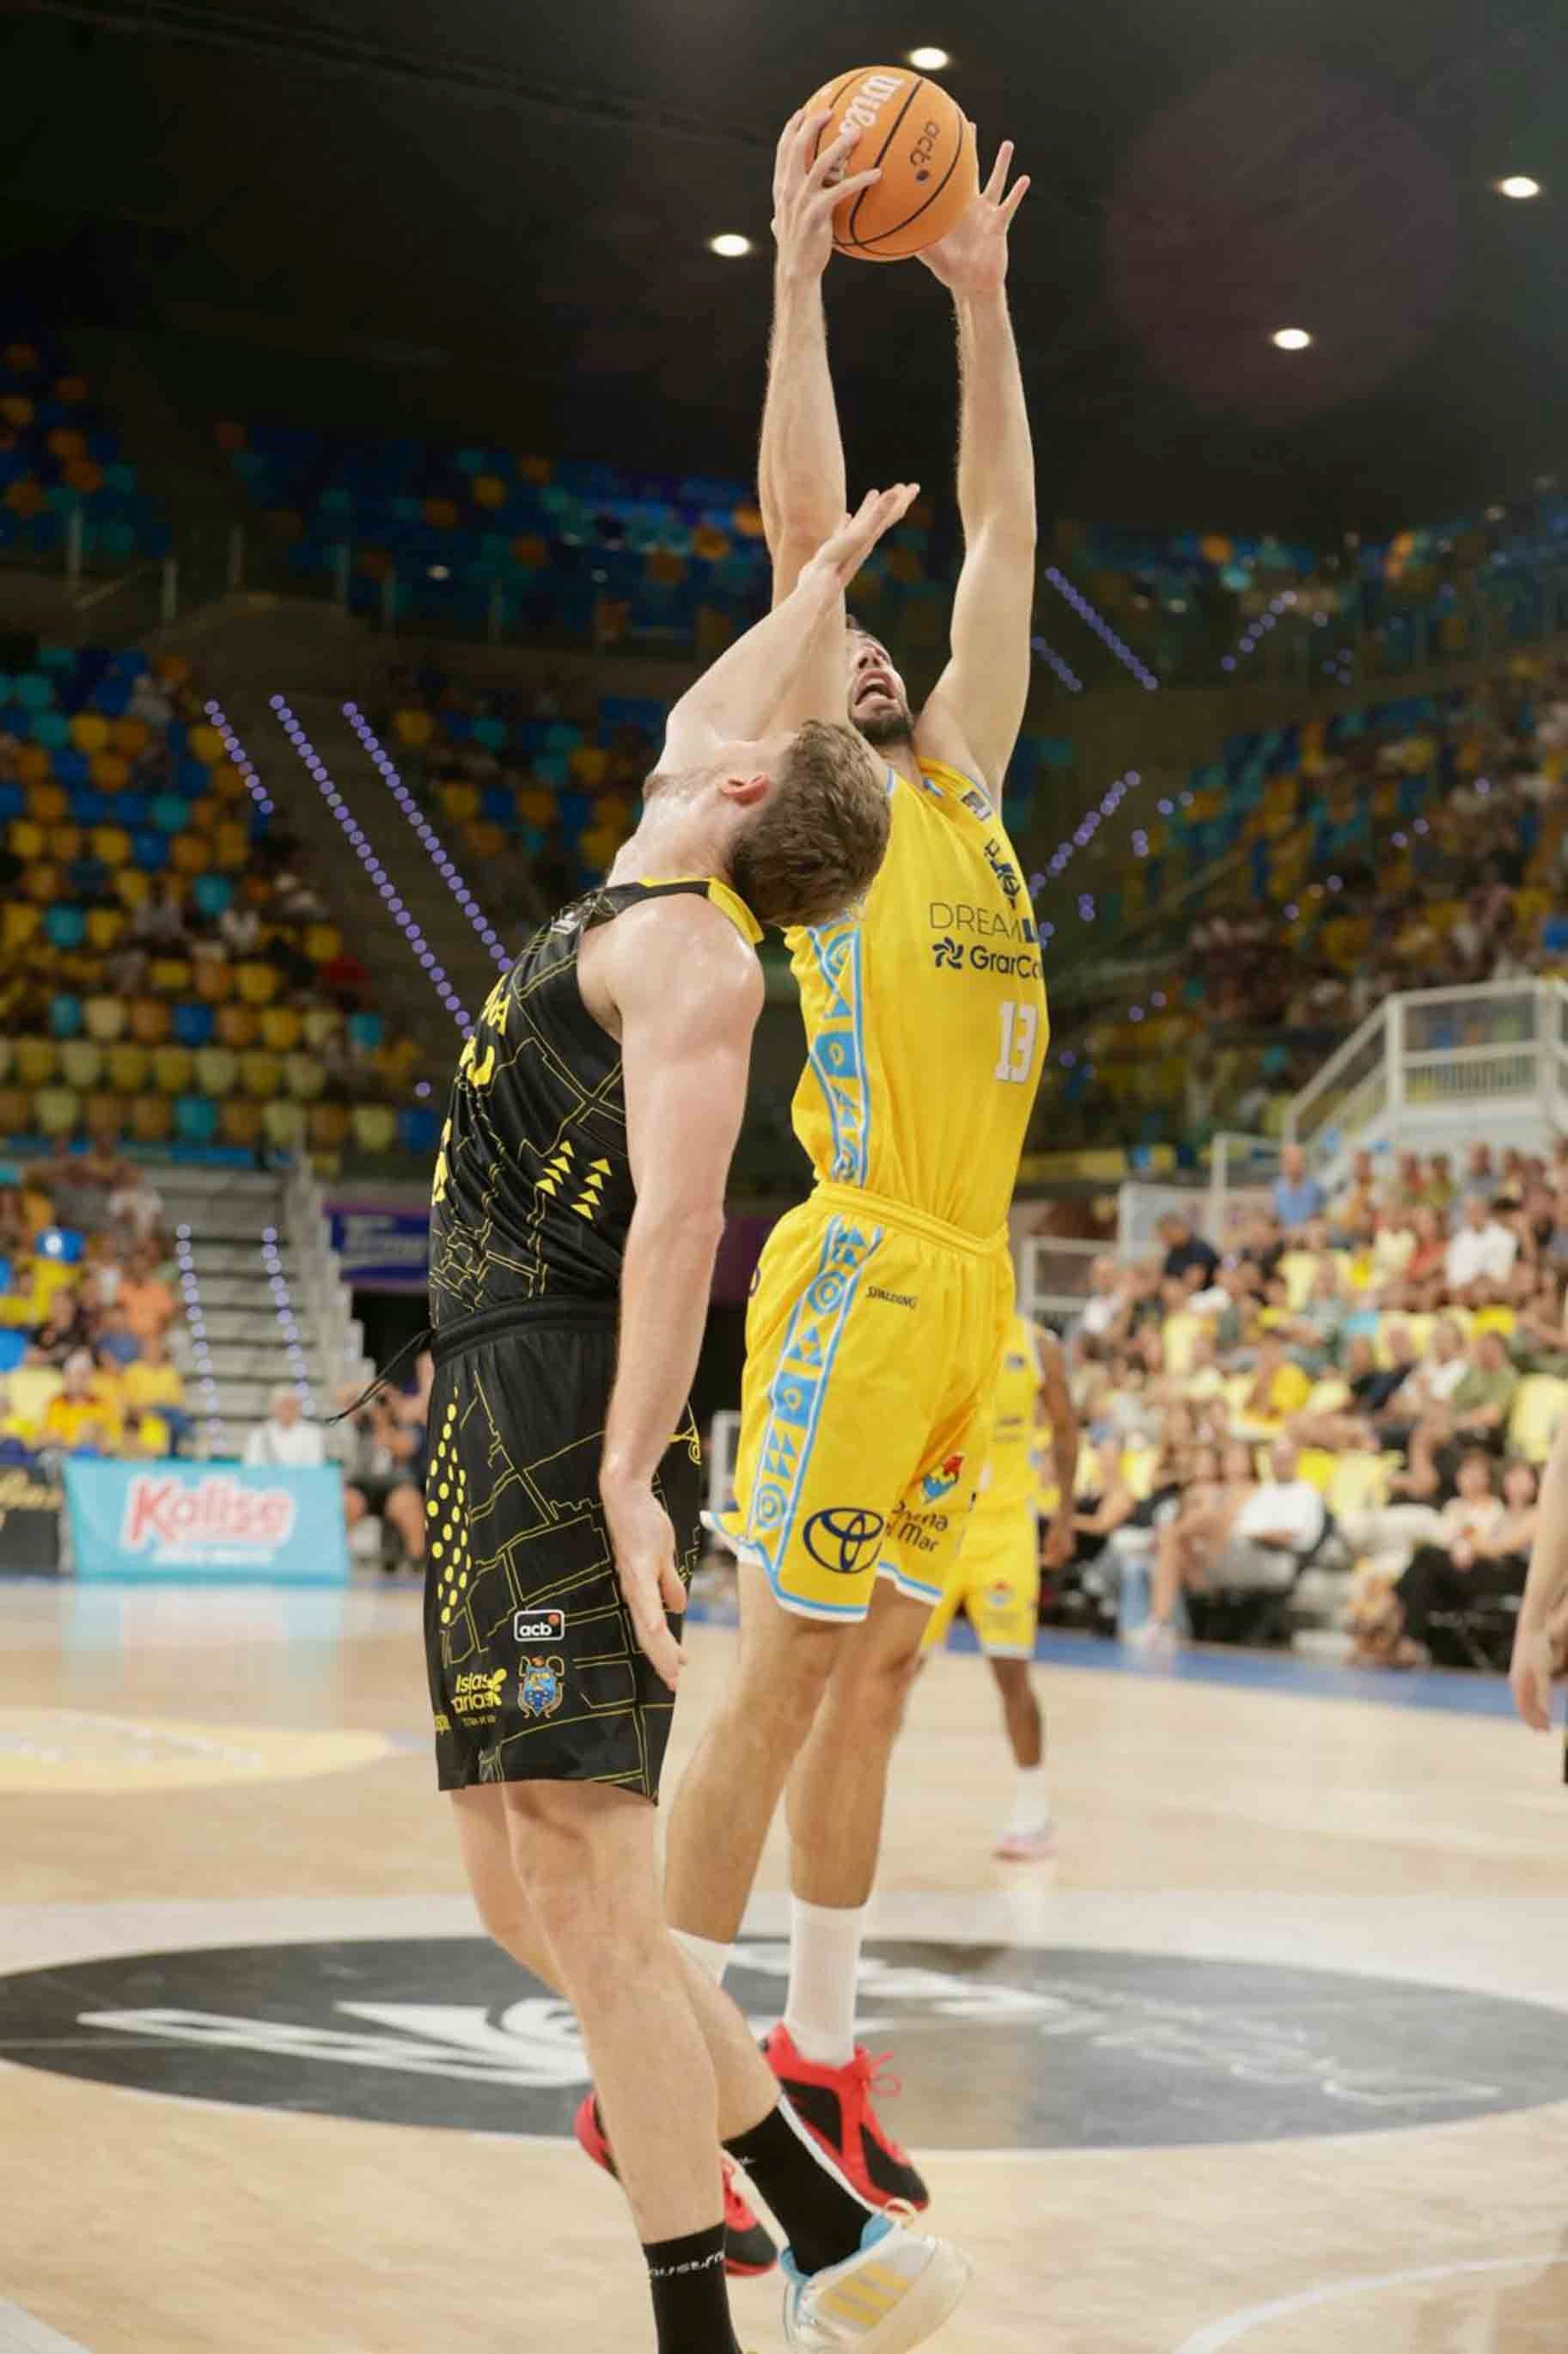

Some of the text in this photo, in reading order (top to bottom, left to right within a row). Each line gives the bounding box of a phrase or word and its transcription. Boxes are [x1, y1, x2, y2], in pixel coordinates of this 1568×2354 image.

[993, 1000, 1038, 1083] 13
[128, 1475, 293, 1544] Kalise
[519, 1622, 552, 1637] acb
